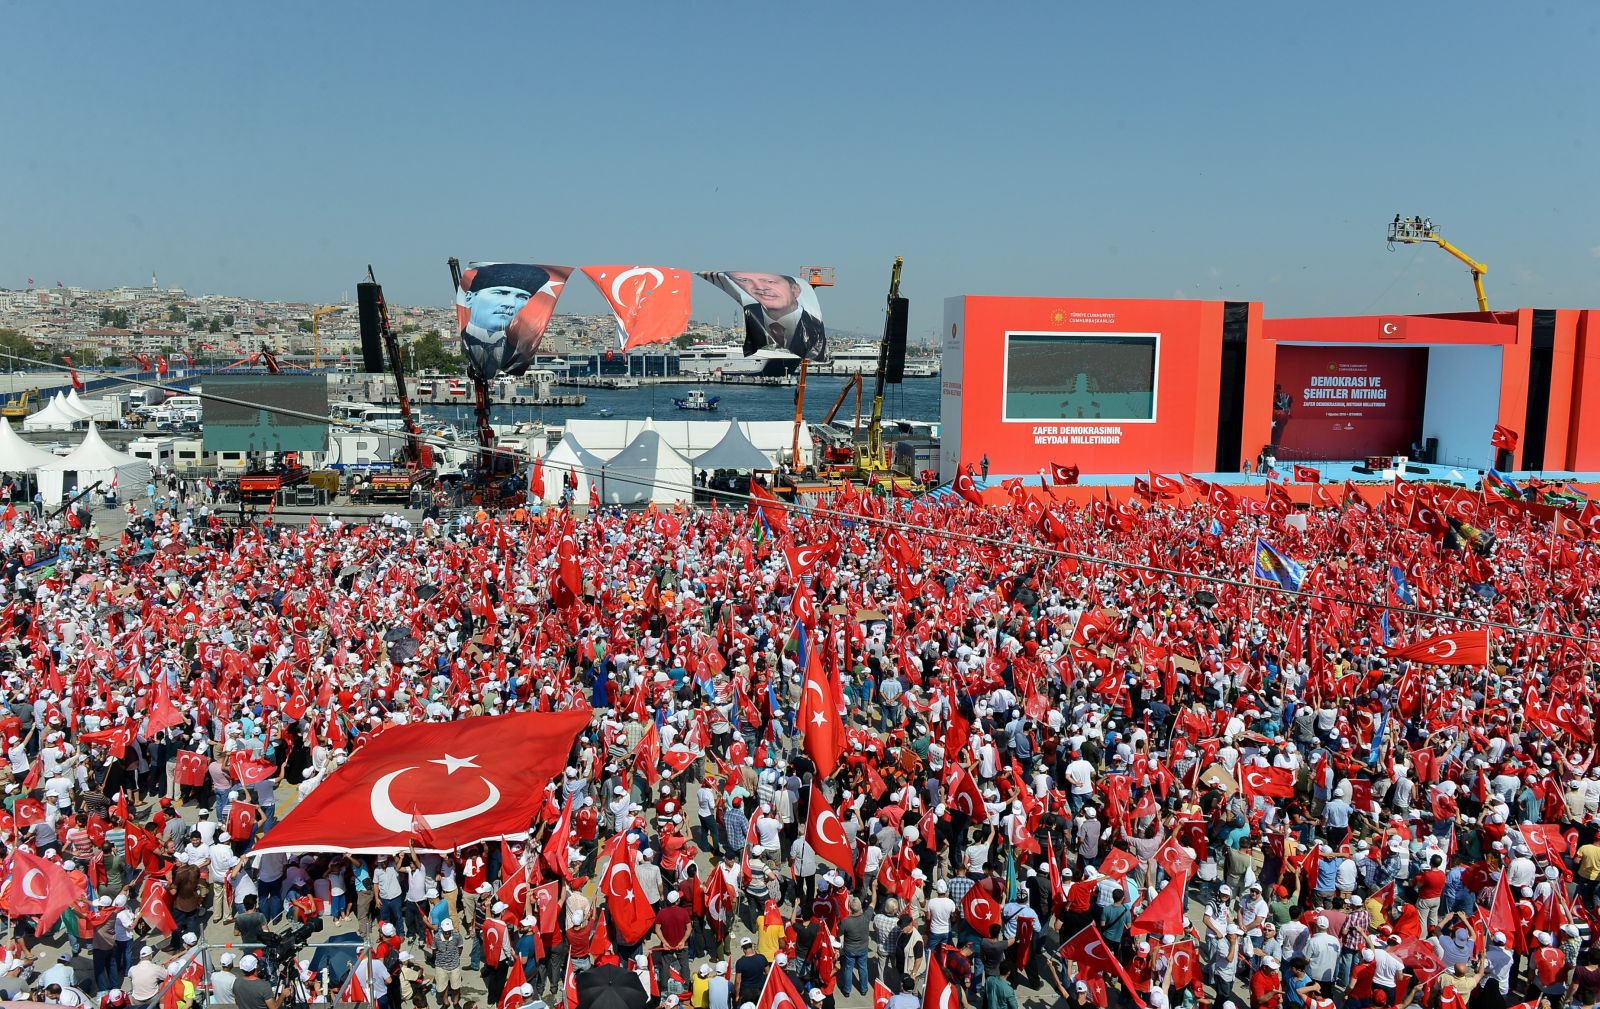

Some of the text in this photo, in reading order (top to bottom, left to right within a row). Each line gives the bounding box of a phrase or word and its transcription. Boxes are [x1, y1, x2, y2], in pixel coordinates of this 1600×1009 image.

[1311, 376, 1380, 386] DEMOKRASİ VE
[1304, 388, 1386, 400] ŞEHİTLER MİTİNGİ
[1032, 426, 1122, 436] ZAFER DEMOKRASİNİN,
[1034, 436, 1120, 444] MEYDAN MİLLETİNDİR
